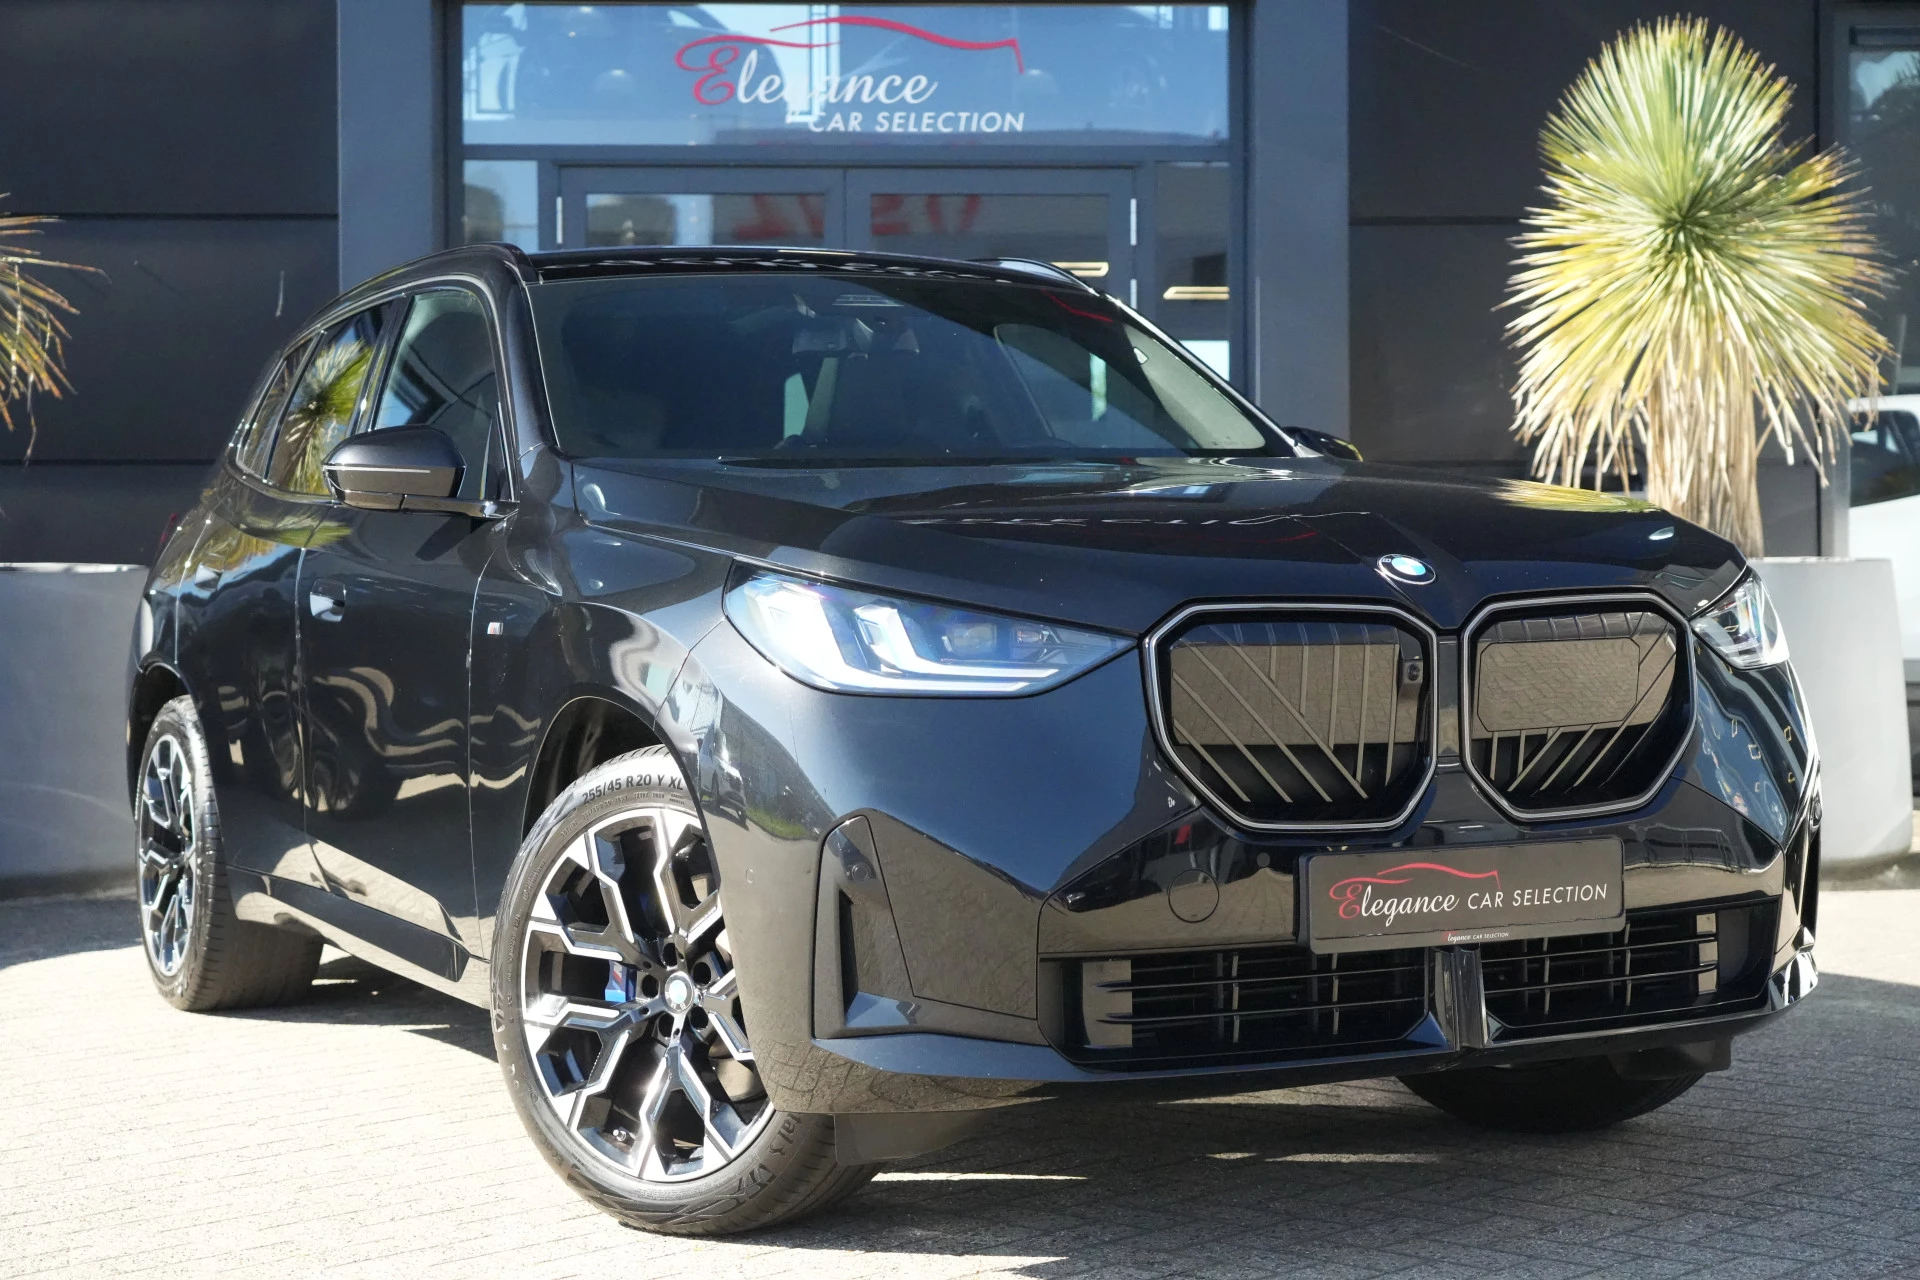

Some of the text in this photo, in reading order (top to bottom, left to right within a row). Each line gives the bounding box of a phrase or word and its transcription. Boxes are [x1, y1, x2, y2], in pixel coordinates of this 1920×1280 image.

[807, 111, 1025, 132] CAR SELECTION
[582, 777, 622, 806] 255/45
[657, 774, 665, 787] Y
[669, 776, 684, 791] XL
[1329, 880, 1608, 928] Elegance CAR SELECTION
